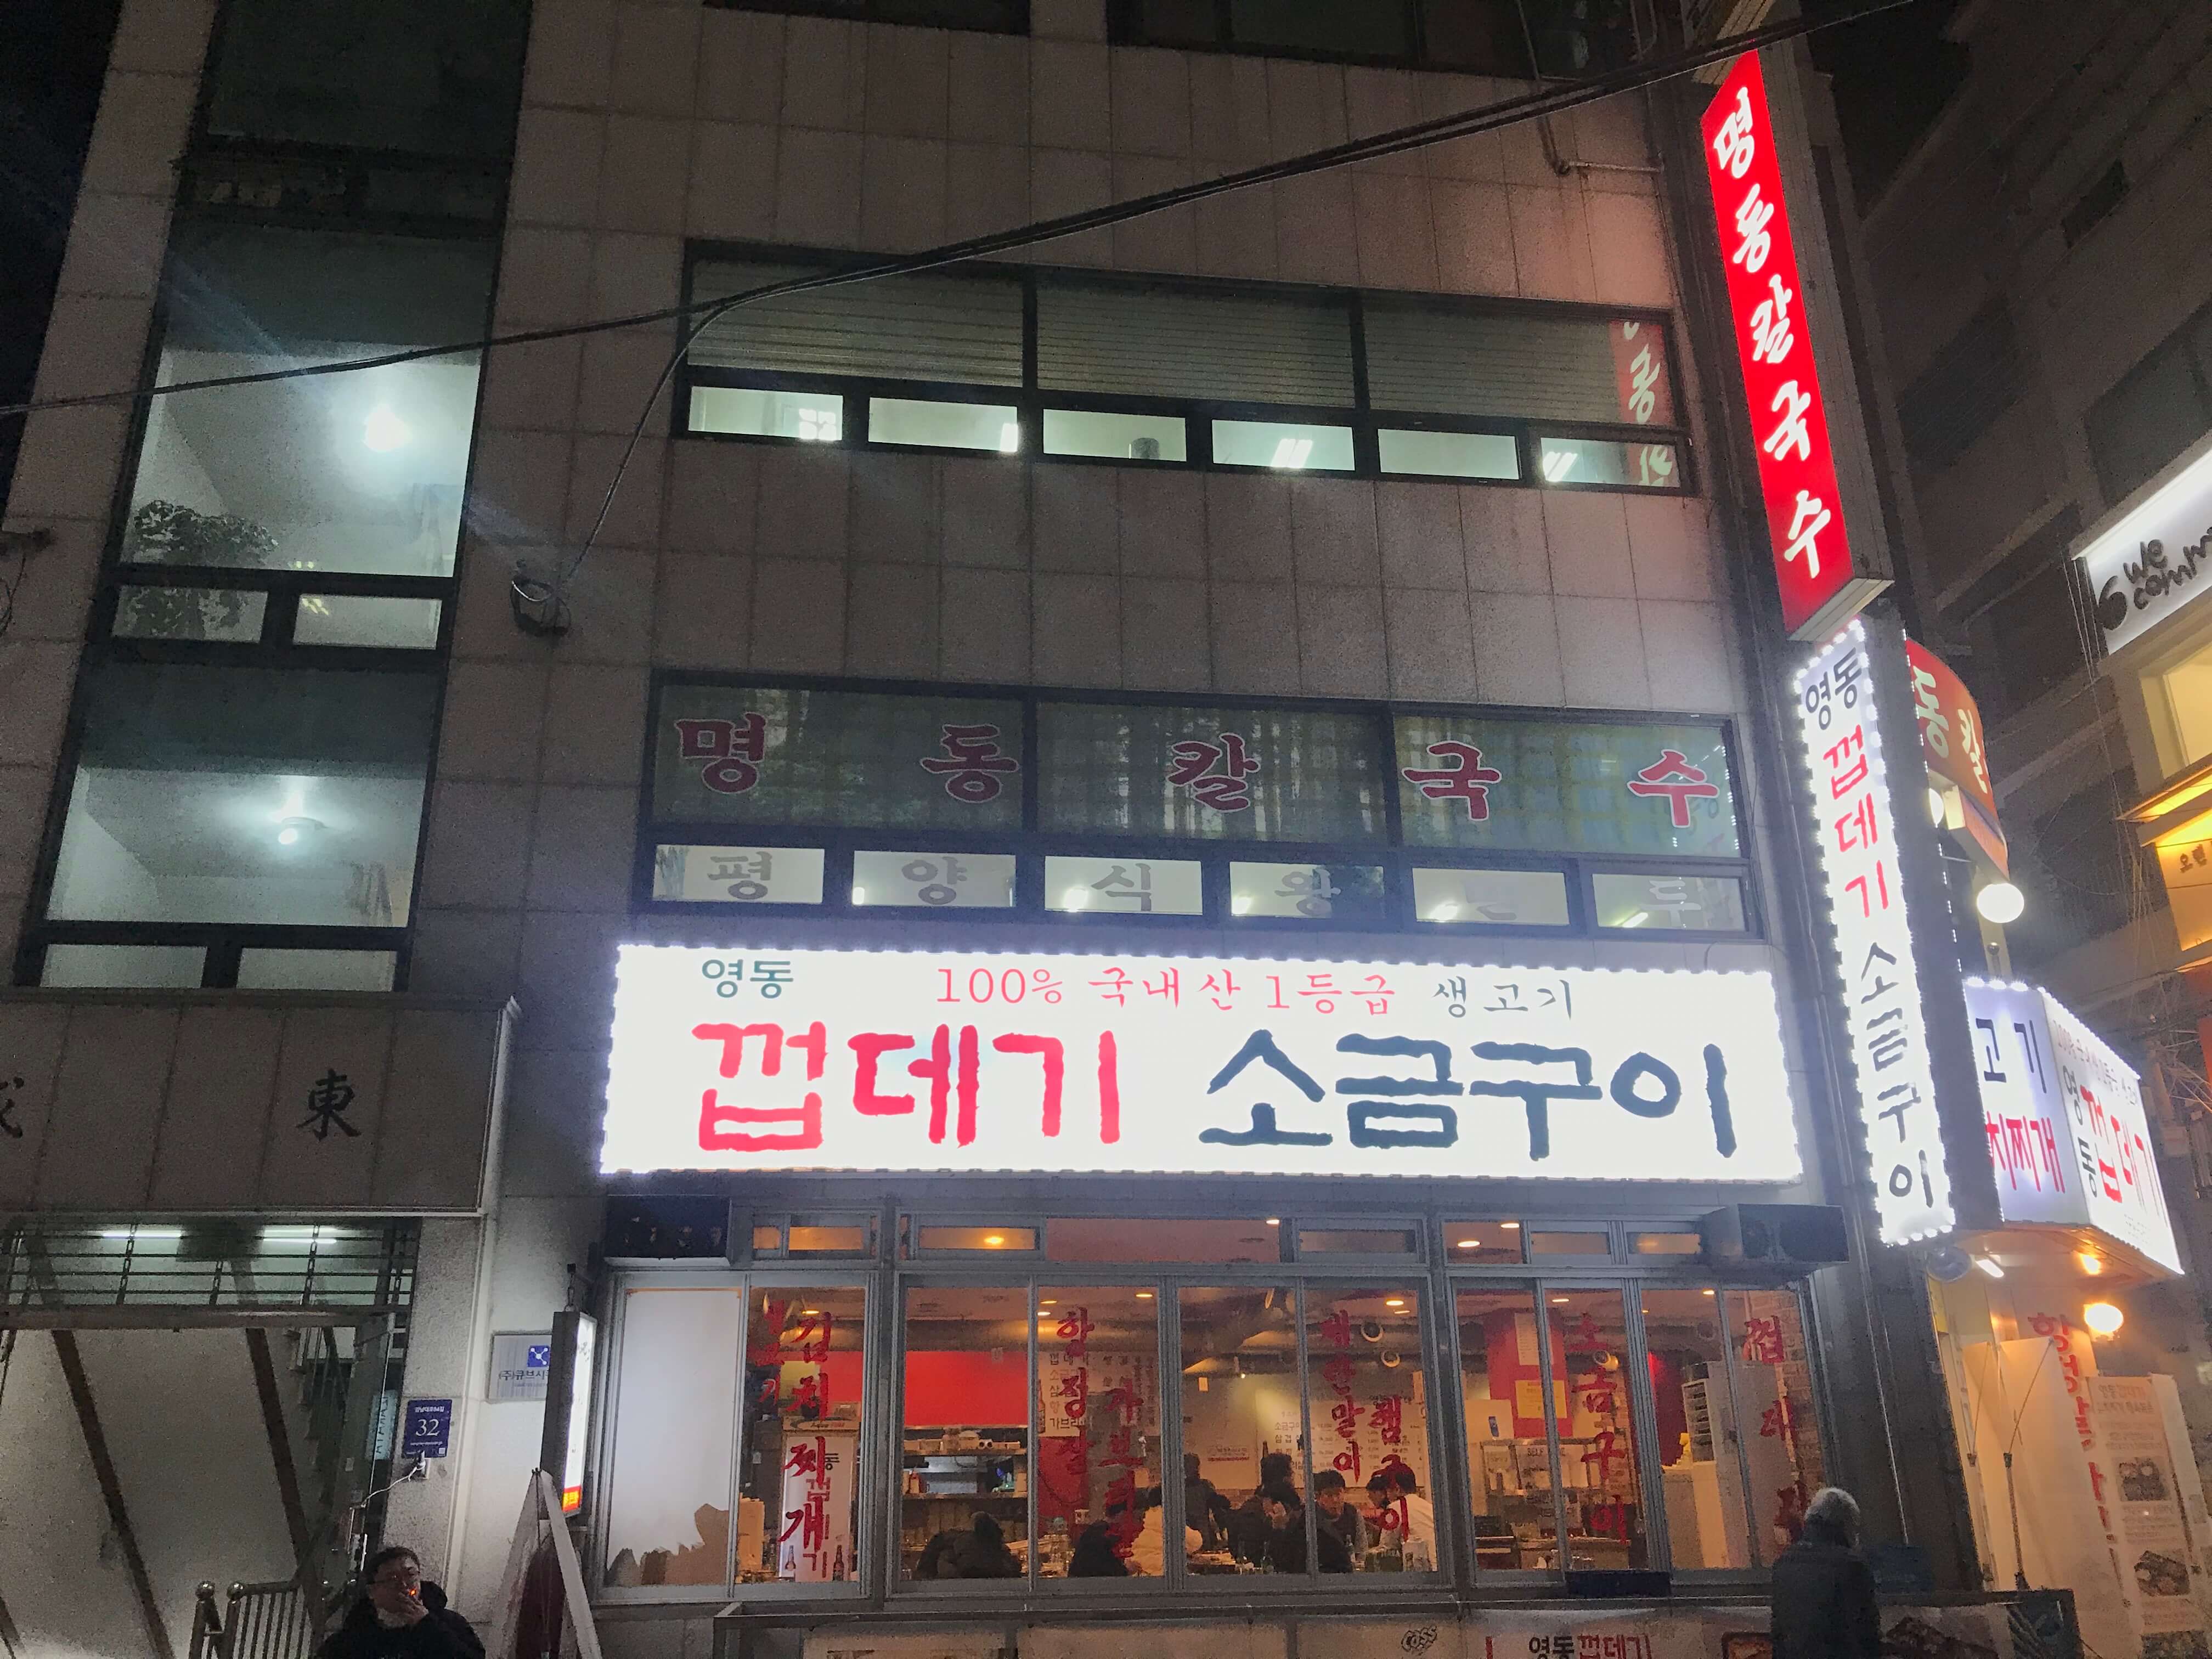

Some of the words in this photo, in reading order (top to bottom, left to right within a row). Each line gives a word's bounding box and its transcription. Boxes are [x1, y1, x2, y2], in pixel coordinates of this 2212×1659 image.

[1713, 86, 1831, 579] 명동칼국수
[1805, 647, 1862, 730] 영동
[1823, 724, 1888, 918] 껍데기
[701, 958, 794, 1000] 영동
[936, 967, 1064, 1005] 100%
[1087, 967, 1241, 1009] 국내산
[1266, 973, 1396, 1015] 1등급
[1432, 979, 1575, 1020] 생고기
[295, 1068, 363, 1142] 東
[691, 1020, 1121, 1152] 껍데기
[1198, 1028, 1737, 1161] 소금구이
[1861, 941, 1933, 1209] 소금구이
[415, 1418, 441, 1437] 32
[777, 1311, 832, 1553] 김치찌개
